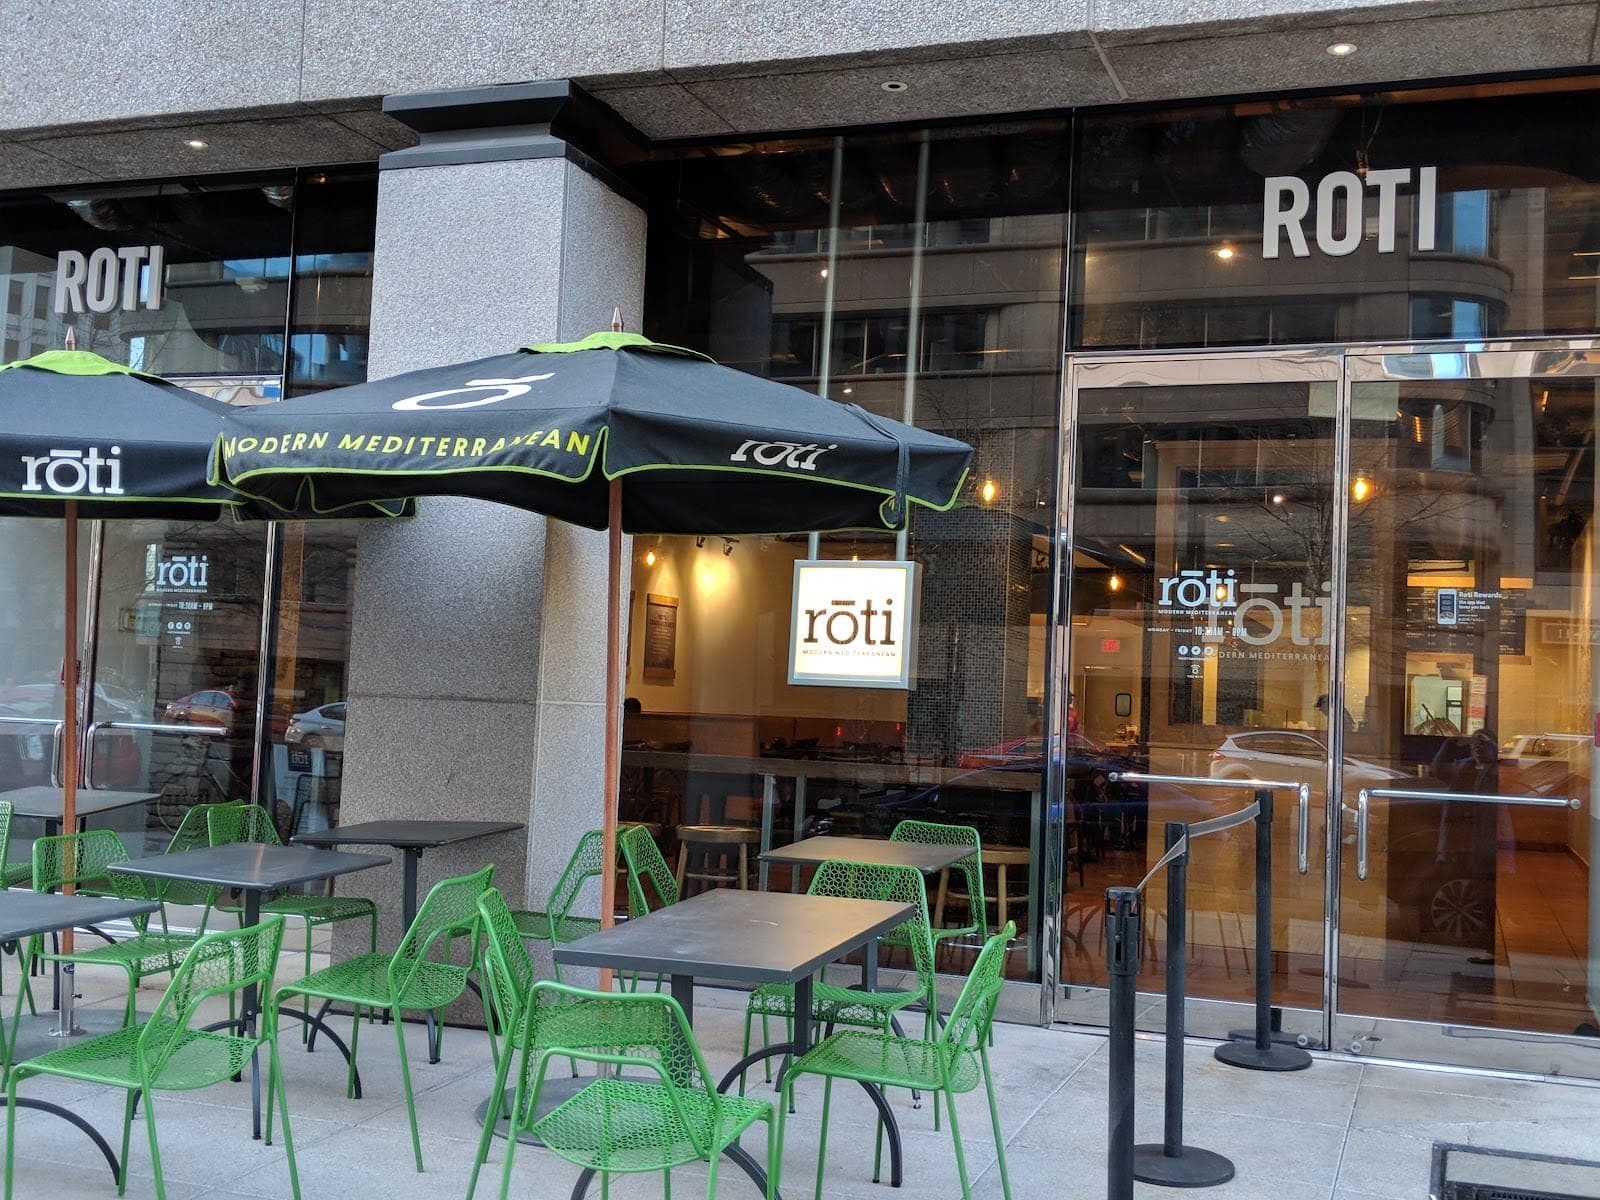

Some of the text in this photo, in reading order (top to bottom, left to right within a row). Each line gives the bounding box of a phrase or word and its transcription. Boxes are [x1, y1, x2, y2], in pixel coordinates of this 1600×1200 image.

[1262, 166, 1437, 259] ROTI
[54, 245, 163, 314] ROTI
[224, 431, 329, 461] MODERN
[1473, 591, 1502, 599] Rewards
[1248, 652, 1330, 662] MEDITERRANEA
